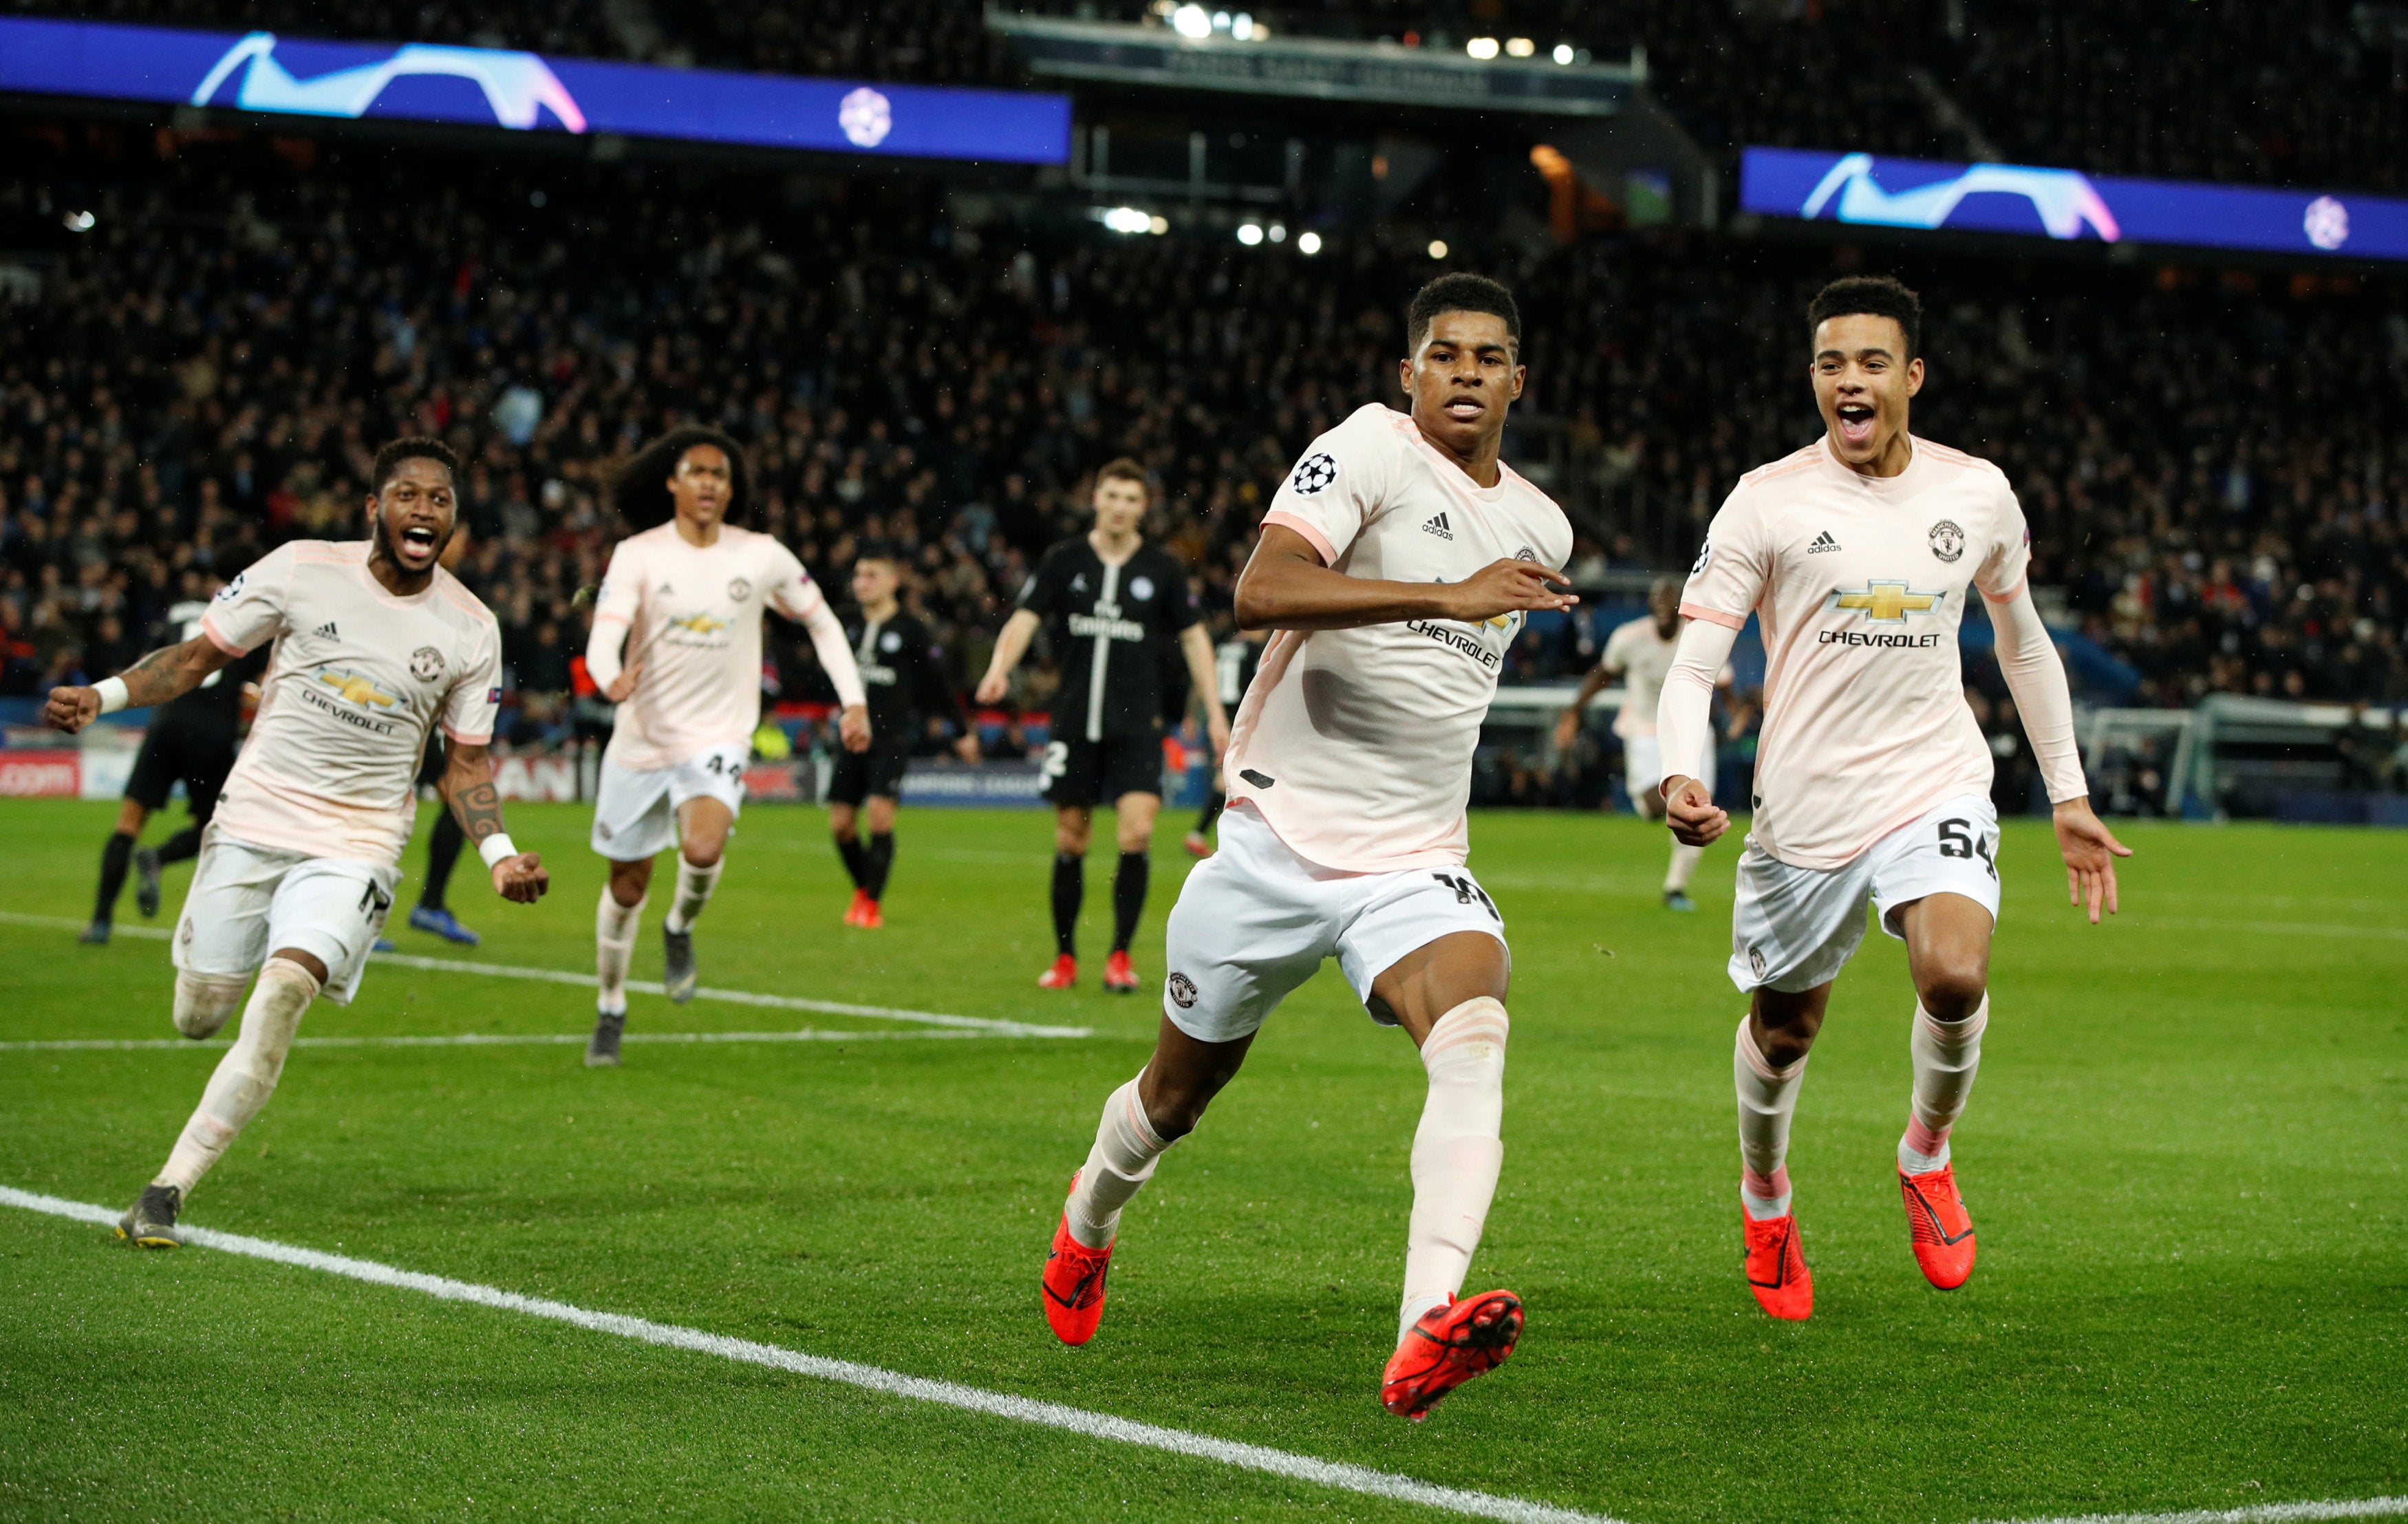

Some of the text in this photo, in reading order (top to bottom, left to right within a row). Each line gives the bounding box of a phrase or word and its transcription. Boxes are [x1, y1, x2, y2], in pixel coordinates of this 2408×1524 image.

[1422, 523, 1454, 541] adidas
[1931, 522, 1963, 537] MANCHESTER
[1807, 542, 1842, 554] adidas
[1937, 552, 1959, 561] UNITED
[1406, 619, 1498, 669] CHEVROLET
[1818, 630, 1940, 648] CHEVROLET
[302, 689, 396, 736] CHEVROLET
